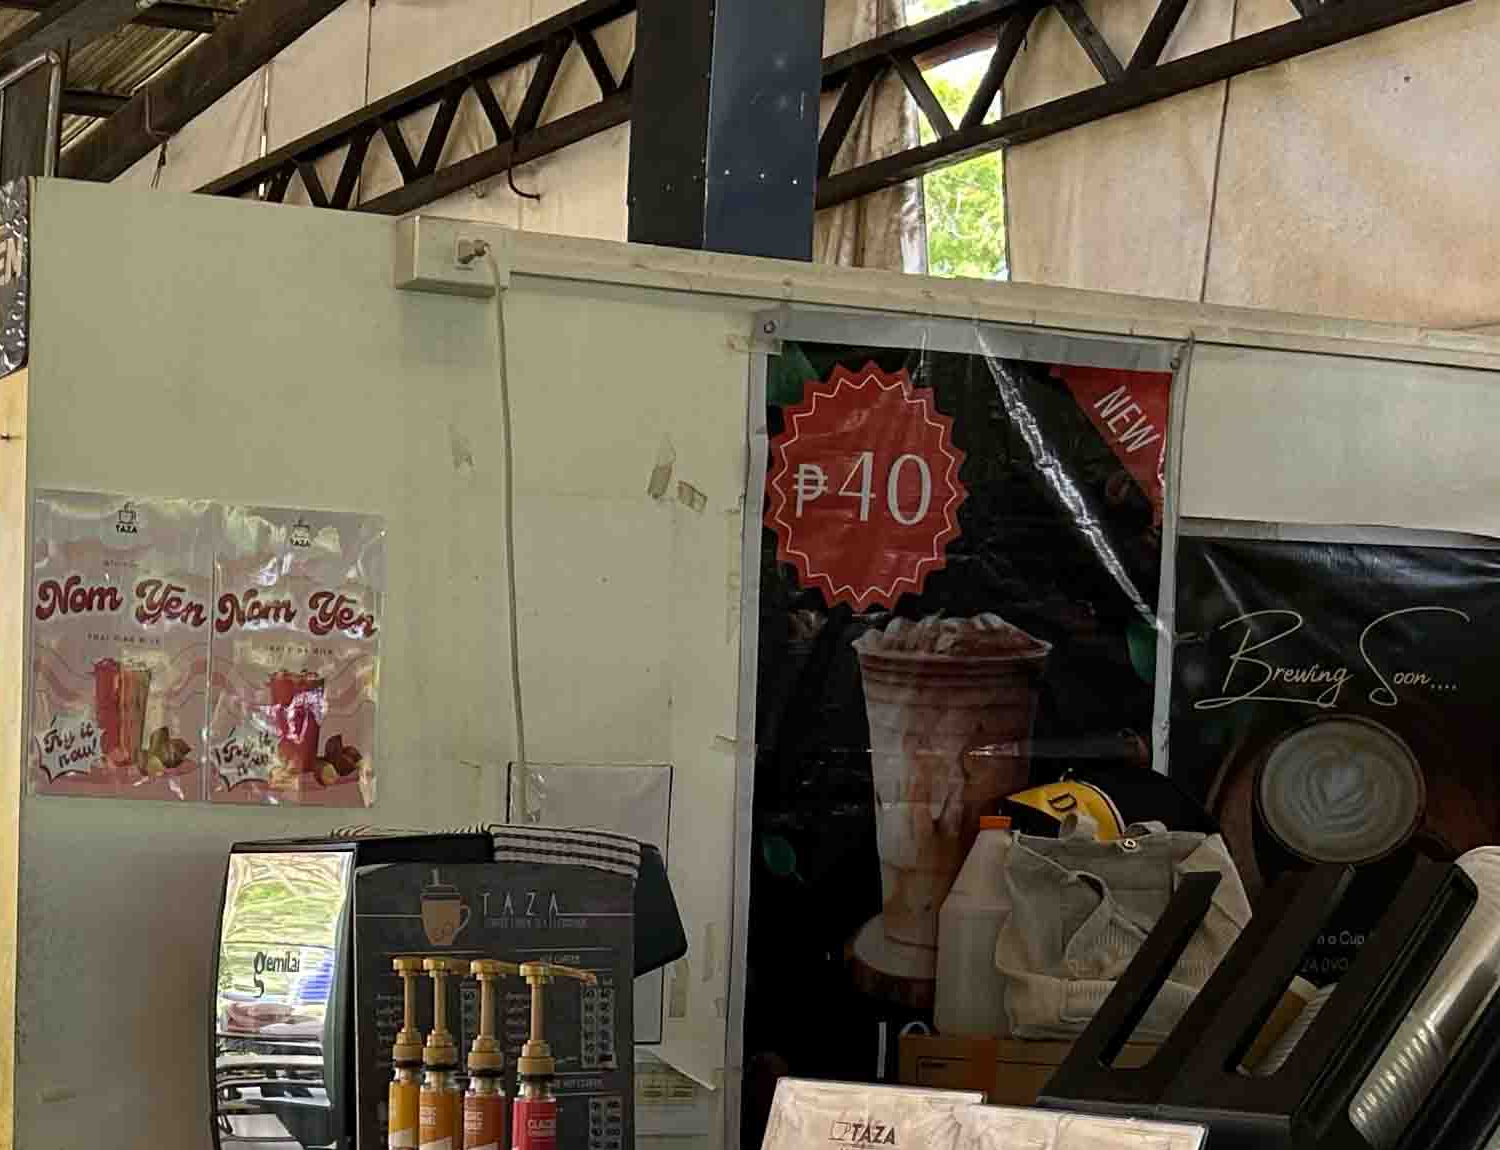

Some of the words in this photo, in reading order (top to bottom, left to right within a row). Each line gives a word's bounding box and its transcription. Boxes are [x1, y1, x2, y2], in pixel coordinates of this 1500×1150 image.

[1093, 385, 1161, 455] NEW
[793, 450, 933, 526] ₱40
[35, 575, 123, 621] Nom
[135, 578, 208, 628] Yen
[214, 588, 297, 634] Nom
[308, 591, 377, 637] Yen
[1194, 609, 1355, 709] Brewing
[80, 722, 94, 737] it
[481, 891, 559, 917] TAZA
[852, 1122, 897, 1146] TAZA
